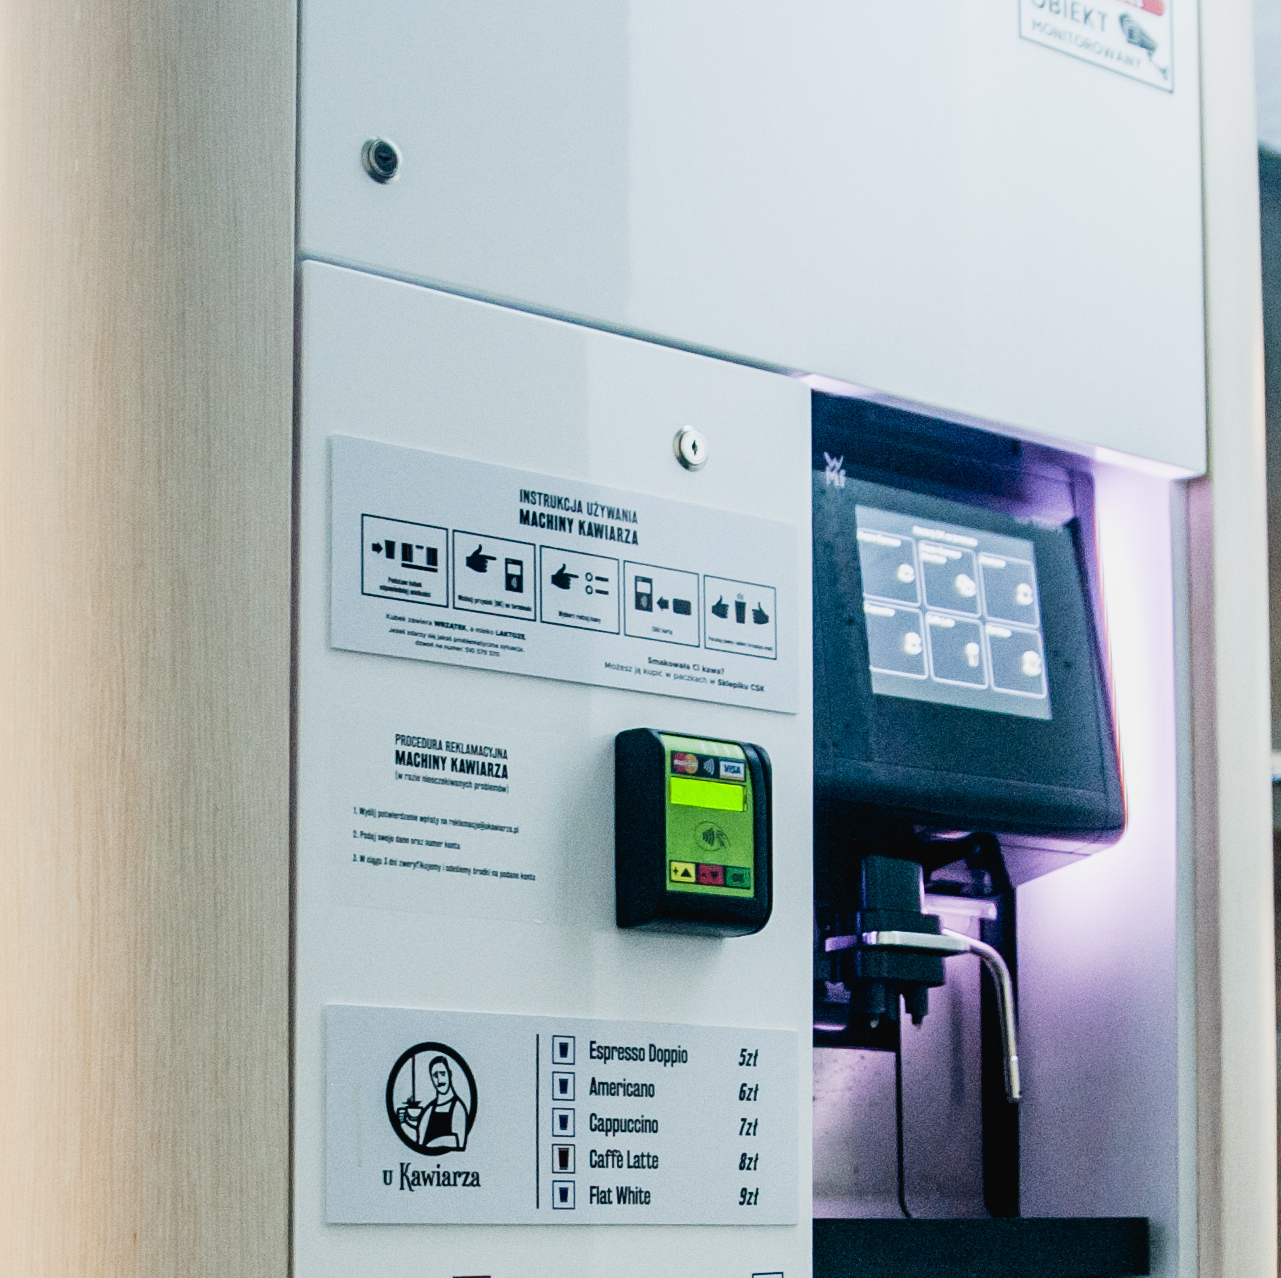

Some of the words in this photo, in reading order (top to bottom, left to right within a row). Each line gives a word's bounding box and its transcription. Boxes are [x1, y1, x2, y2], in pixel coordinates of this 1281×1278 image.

[520, 489, 583, 513] INSTRUKCJA
[587, 502, 637, 523] UŻYWANIA
[520, 509, 573, 533] MACHINY
[578, 520, 638, 545] KAWIARZA
[395, 734, 443, 750] PROCEDURA
[446, 741, 508, 759] REKLAMACYJNA
[395, 750, 447, 770] MACHINY
[451, 758, 508, 779] KAWIARZA
[723, 763, 742, 776] VISA
[590, 1040, 645, 1064] Espresso
[649, 1044, 688, 1067] Doppio
[738, 1048, 758, 1067] 5zł
[589, 1077, 655, 1098] Americano
[739, 1083, 759, 1101] 6zł
[589, 1113, 658, 1137] Cappuccino
[739, 1118, 758, 1136] 7zł
[590, 1149, 623, 1168] Caffè
[627, 1150, 658, 1169] Latte
[739, 1153, 758, 1171] 8zł
[400, 1162, 481, 1192] Kawiarza
[590, 1186, 613, 1204] Flat
[616, 1186, 651, 1205] White
[739, 1187, 759, 1205] 9zł
